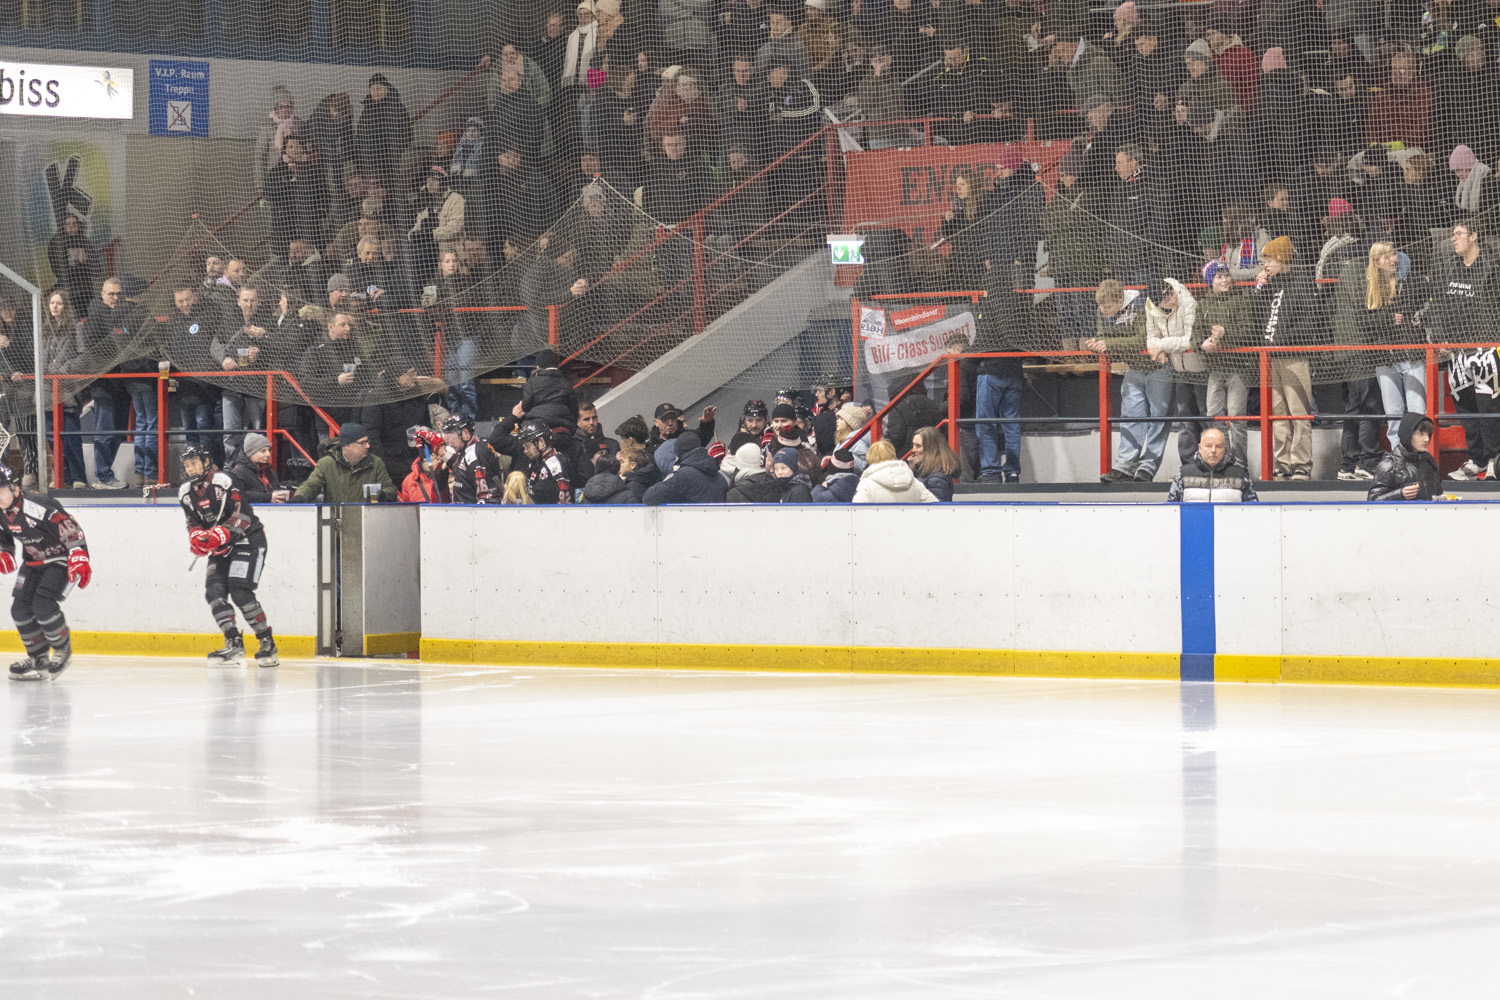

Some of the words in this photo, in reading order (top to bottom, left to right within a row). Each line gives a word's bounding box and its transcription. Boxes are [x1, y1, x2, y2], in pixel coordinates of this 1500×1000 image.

[155, 68, 177, 77] V.I.P.
[180, 69, 205, 79] Raum
[165, 84, 194, 95] Treppe
[1265, 290, 1284, 342] TOMMY
